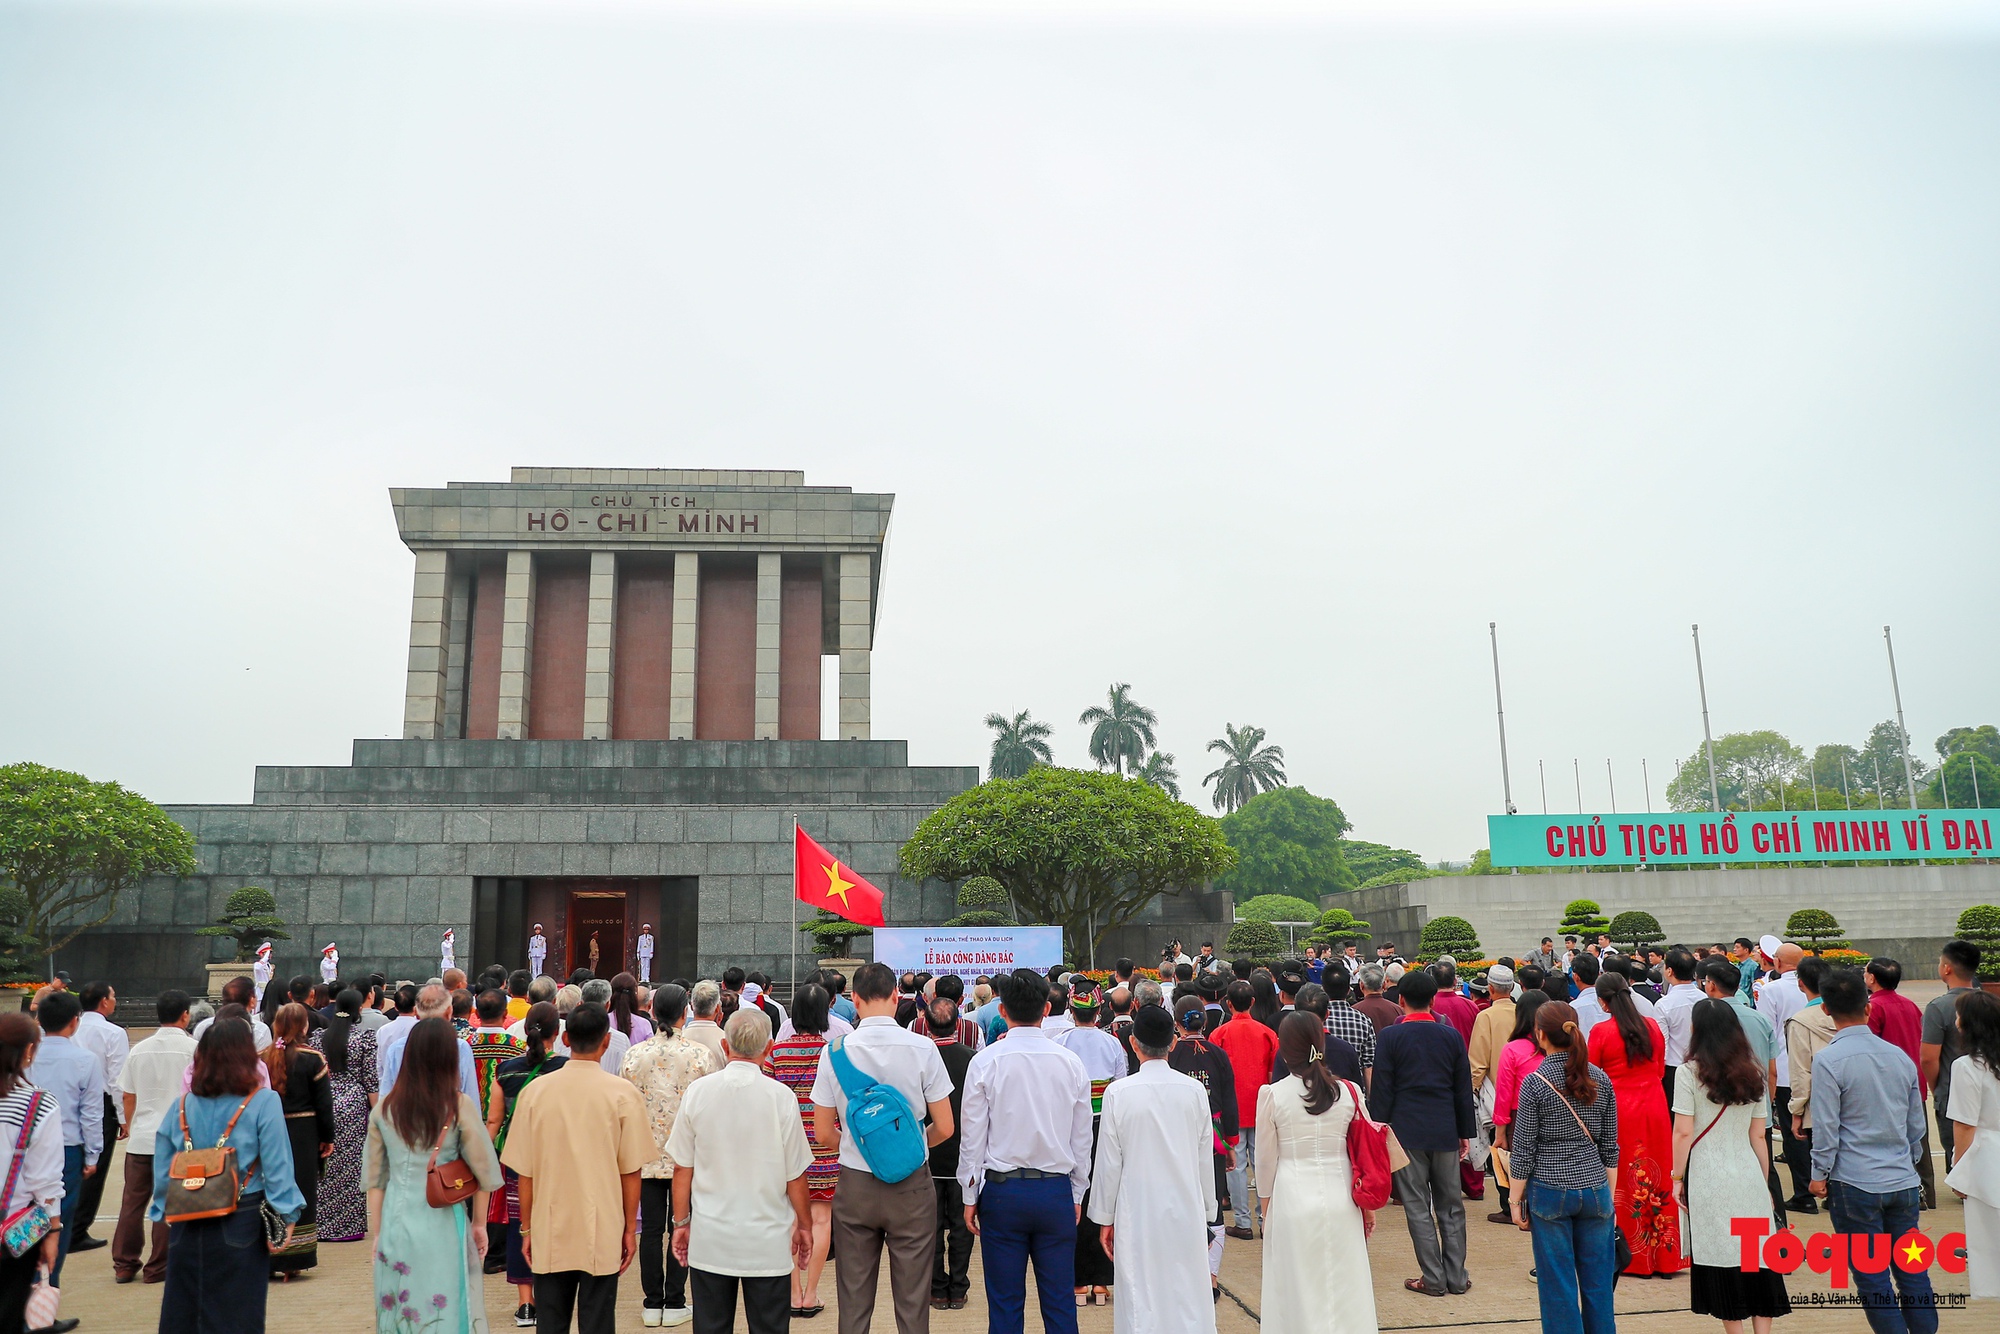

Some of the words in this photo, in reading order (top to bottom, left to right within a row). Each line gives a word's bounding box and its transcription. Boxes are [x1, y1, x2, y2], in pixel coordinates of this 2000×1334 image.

[527, 508, 570, 532] HỒ
[597, 508, 649, 533] CHÍ
[1545, 815, 1605, 857] CHỦ
[1619, 823, 1688, 862] TỊCH
[1700, 813, 1739, 855] HỒ
[1751, 815, 1802, 854] CHÍ
[1813, 820, 1892, 853] MINH
[1902, 814, 1932, 850] VĨ
[1943, 819, 1993, 856] ĐẠI
[925, 948, 934, 964] LỄ
[936, 951, 951, 964] BÁO
[953, 950, 973, 964] CÔNG
[975, 950, 997, 964] DÂNG
[999, 950, 1014, 964] BÁC
